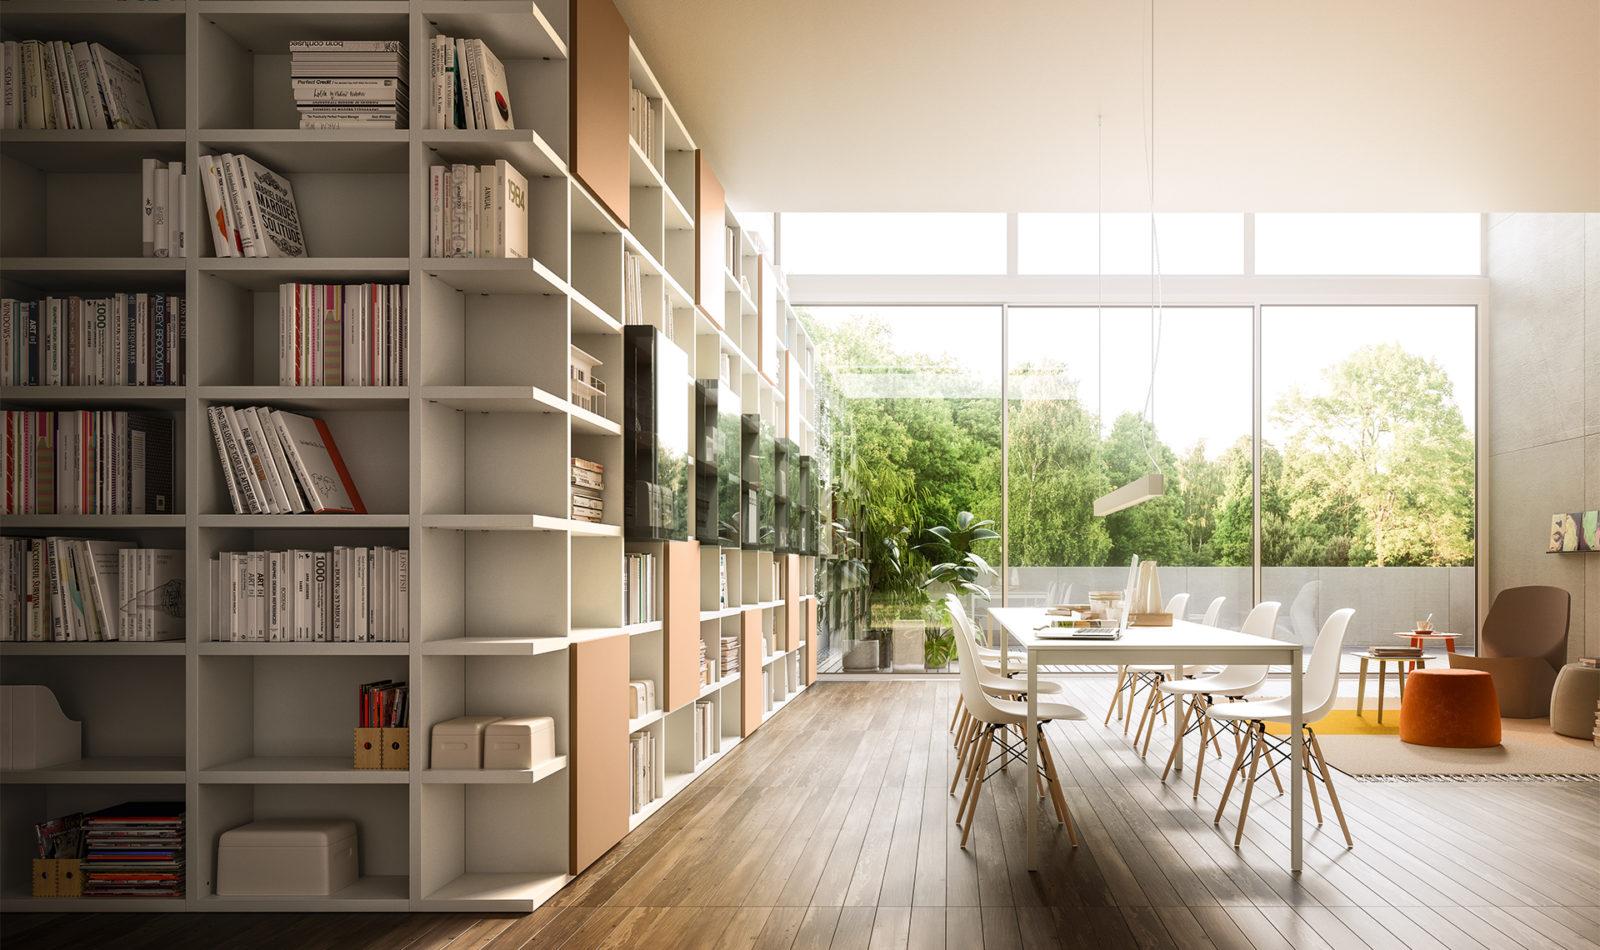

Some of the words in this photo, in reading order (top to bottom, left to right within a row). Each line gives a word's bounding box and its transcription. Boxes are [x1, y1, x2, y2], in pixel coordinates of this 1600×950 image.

[508, 178, 525, 212] 1984
[262, 214, 303, 246] SOLITUDE
[3, 302, 11, 339] WINDOWS
[97, 303, 106, 328] 1000
[155, 294, 164, 327] ALEXEY
[128, 317, 136, 365] ANTIQUAIRES
[155, 328, 164, 383] BRODOVITCH
[316, 556, 325, 582] 1000
[399, 552, 407, 572] LOST
[399, 574, 407, 592] FISH
